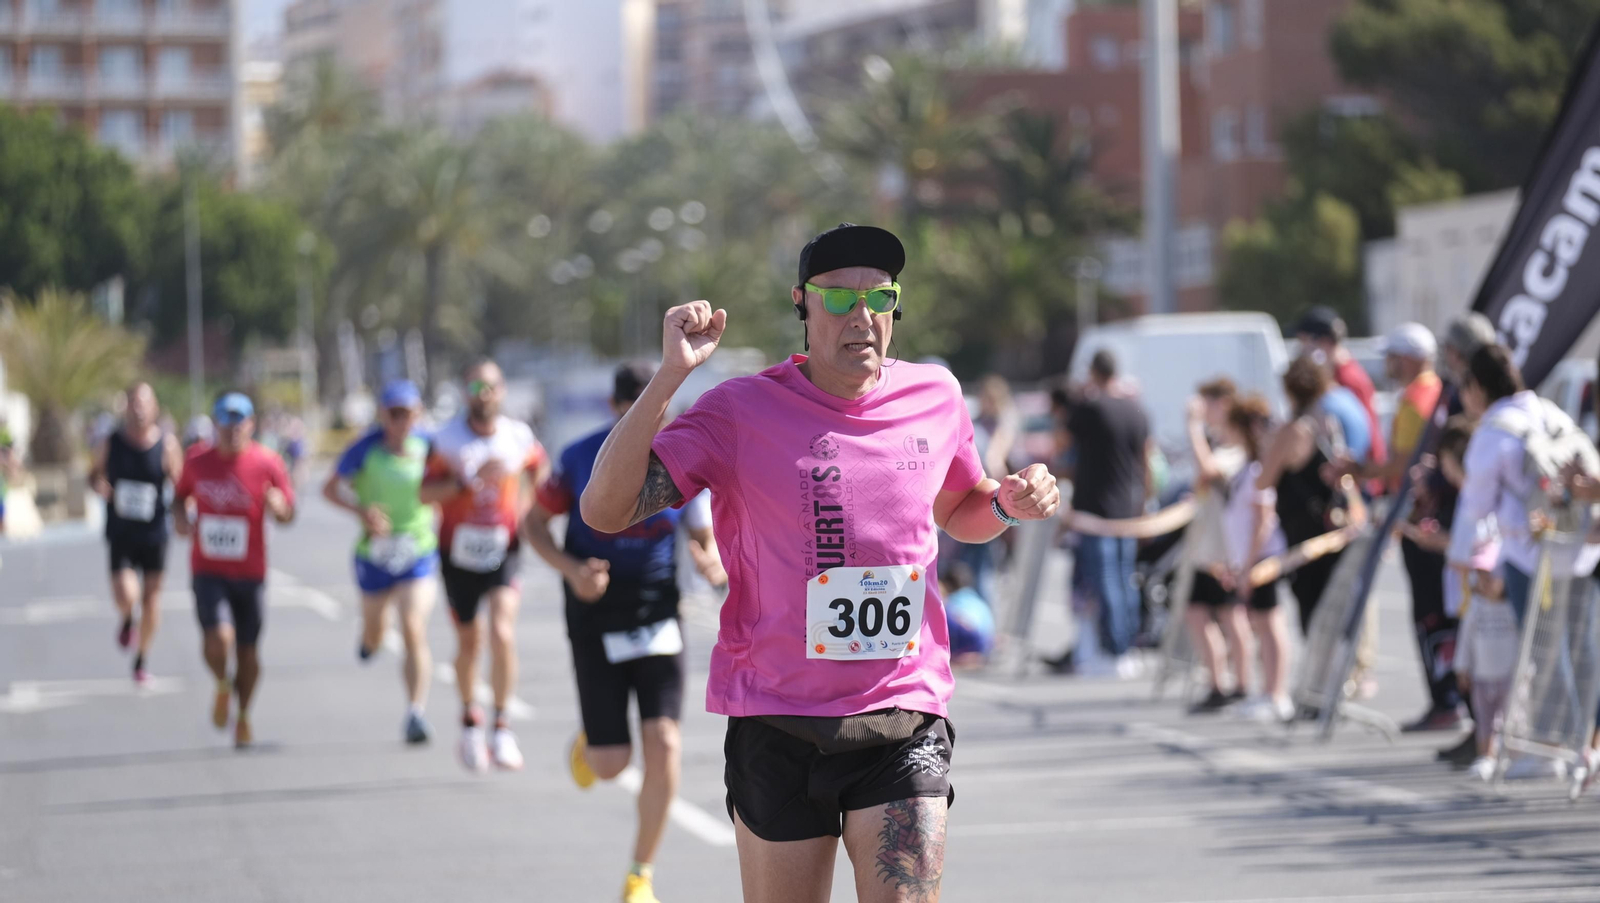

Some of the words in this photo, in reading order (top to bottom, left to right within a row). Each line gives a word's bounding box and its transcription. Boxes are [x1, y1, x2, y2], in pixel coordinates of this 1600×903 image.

[896, 460, 936, 470] 2019
[799, 469, 810, 512] NADO
[812, 465, 845, 575] UERT8S
[845, 478, 857, 560] AGUADULCE
[828, 596, 911, 638] 306
